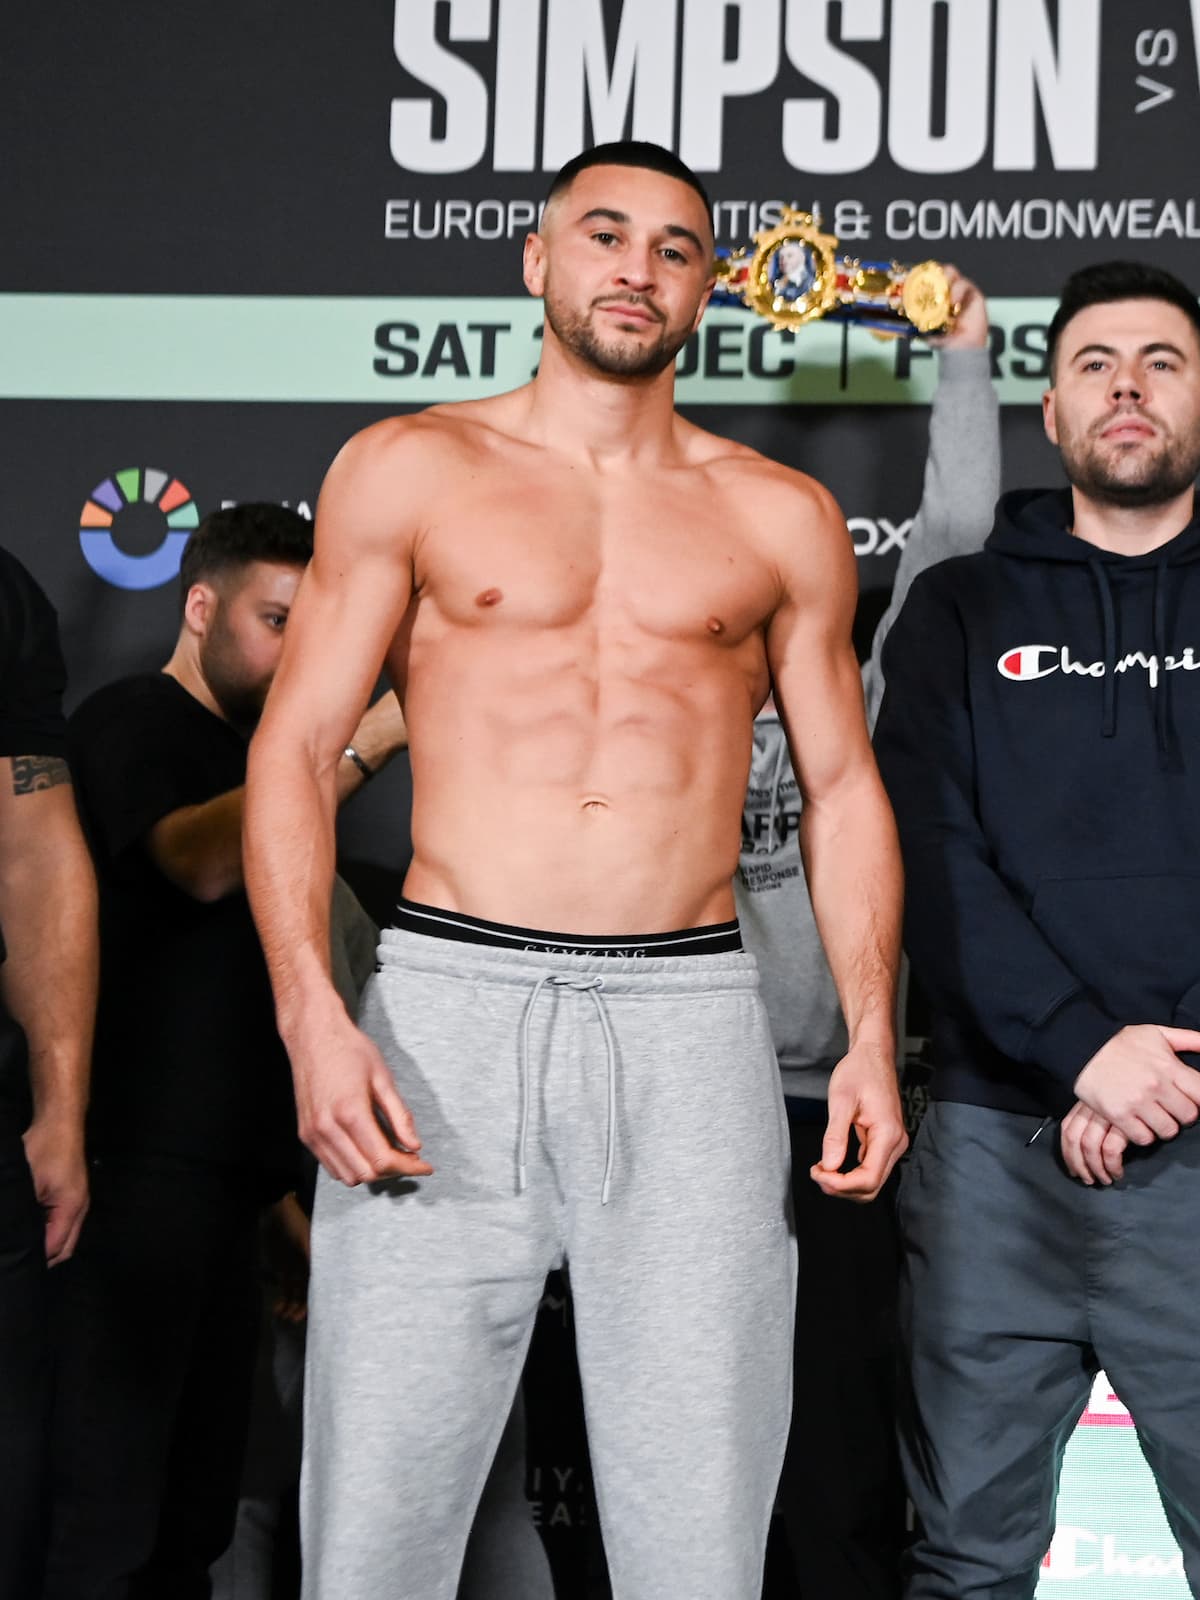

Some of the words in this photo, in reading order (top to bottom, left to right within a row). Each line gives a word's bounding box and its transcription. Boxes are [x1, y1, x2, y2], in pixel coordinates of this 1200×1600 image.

[389, 0, 1098, 174] SIMPSON
[1135, 28, 1178, 114] VS
[384, 199, 546, 240] EUROP
[834, 199, 870, 240] &
[373, 322, 511, 378] SAT
